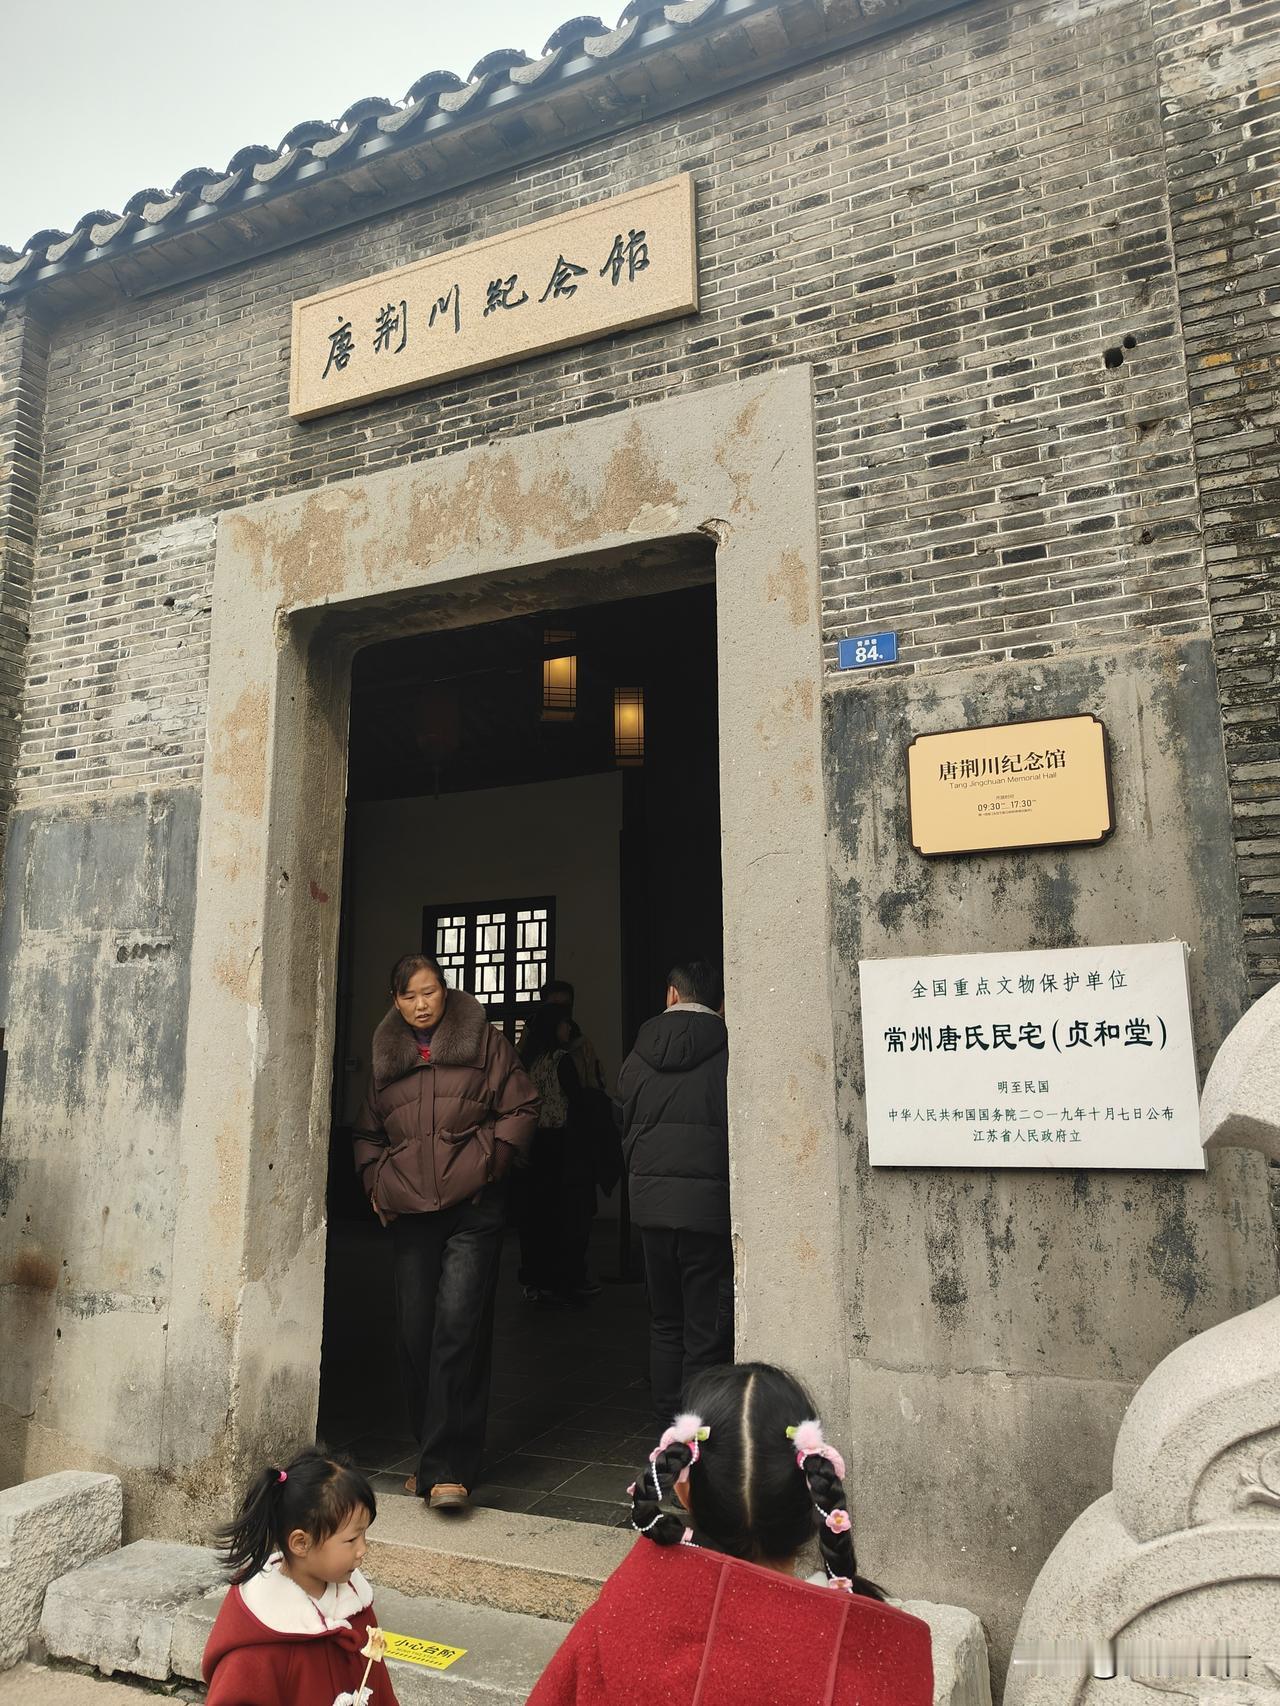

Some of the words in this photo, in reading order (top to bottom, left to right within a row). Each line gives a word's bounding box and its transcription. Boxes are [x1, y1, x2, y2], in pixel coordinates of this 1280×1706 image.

[938, 748, 1066, 781] 唐荆川纪念馆
[949, 782, 968, 790] Tang
[969, 778, 1006, 788] Jingchuan
[1007, 773, 1041, 784] Memorial
[1042, 771, 1057, 780] Hall
[910, 968, 1130, 999] 全国重点文物保护单位
[997, 1080, 1049, 1094] 明至民国
[973, 1128, 1082, 1143] 江苏省人民政府立
[394, 1639, 456, 1659] 小心台阶
